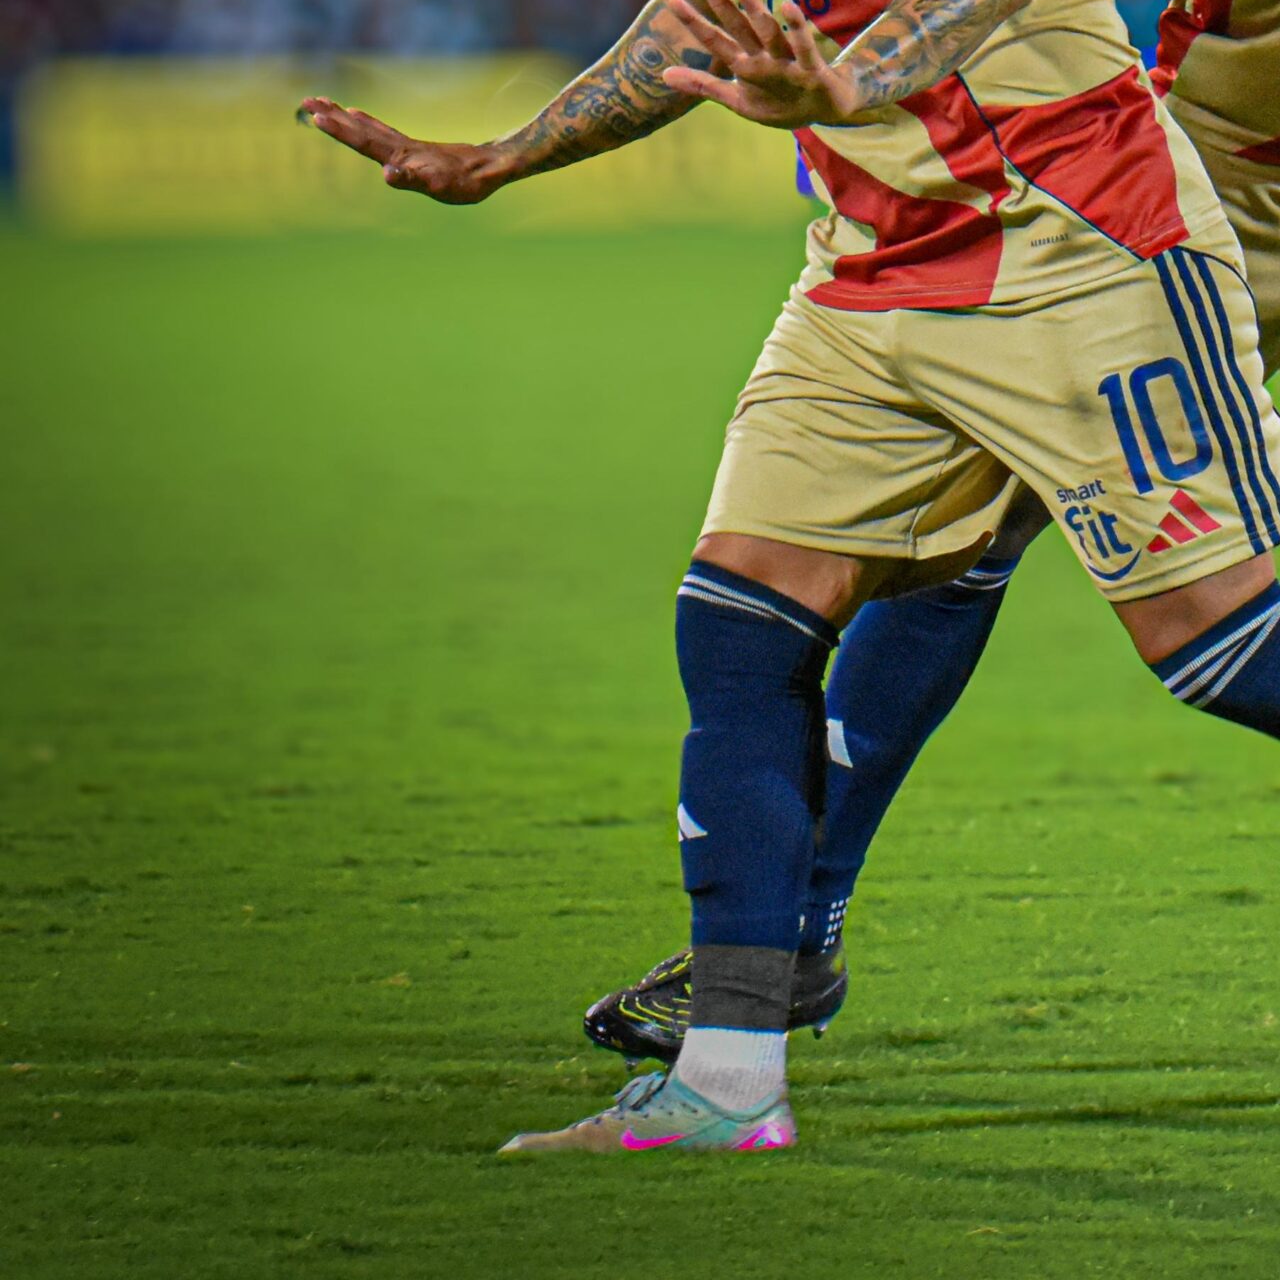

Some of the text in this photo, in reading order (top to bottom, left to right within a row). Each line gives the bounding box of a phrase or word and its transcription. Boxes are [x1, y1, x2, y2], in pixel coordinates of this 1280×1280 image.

[1097, 356, 1213, 495] 10
[1056, 478, 1107, 504] smart
[1064, 505, 1134, 560] fit
